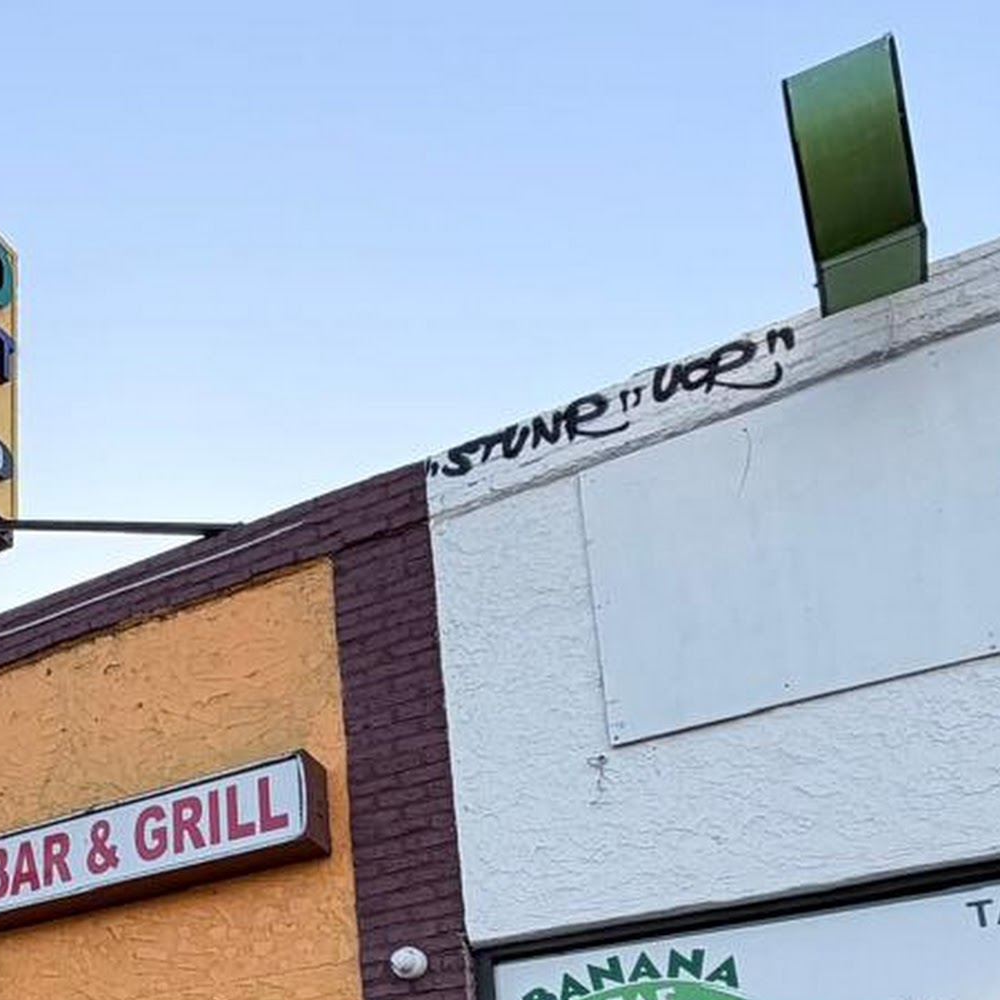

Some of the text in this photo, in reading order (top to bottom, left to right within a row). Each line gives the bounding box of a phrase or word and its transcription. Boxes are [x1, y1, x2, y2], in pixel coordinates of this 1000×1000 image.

[87, 818, 119, 874] &
[135, 776, 289, 860] GRILL
[965, 898, 1000, 928] T
